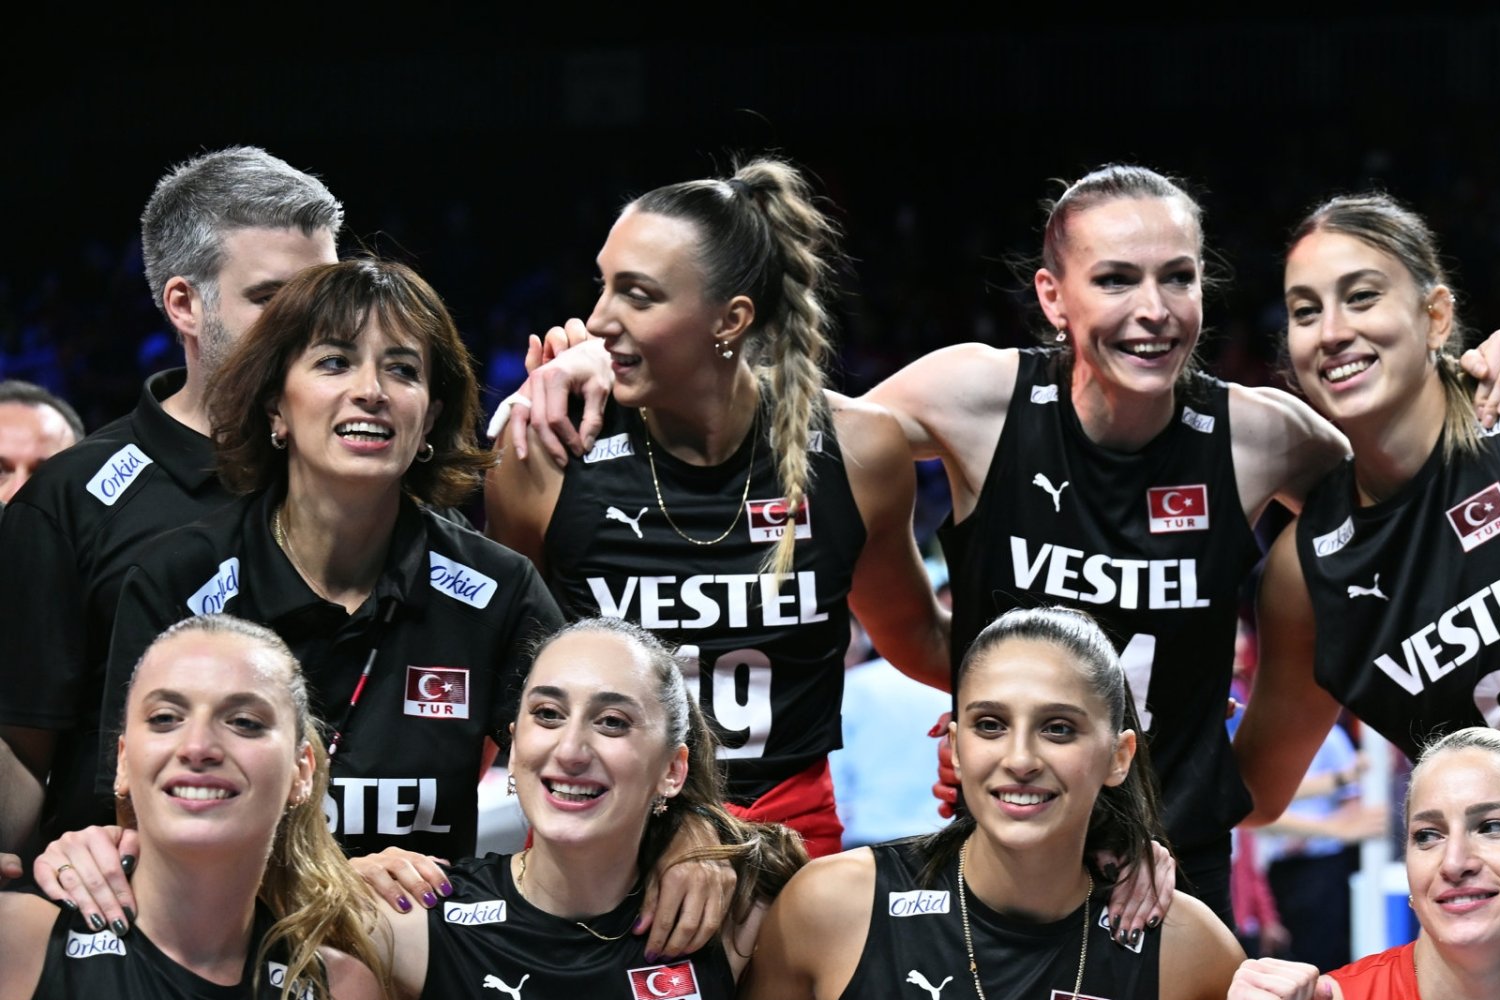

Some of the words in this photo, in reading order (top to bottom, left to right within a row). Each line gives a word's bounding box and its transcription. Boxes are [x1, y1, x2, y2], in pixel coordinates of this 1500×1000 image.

[99, 453, 144, 498] Orkid
[1164, 518, 1196, 529] TUR
[430, 566, 482, 601] Orkid
[1009, 536, 1211, 609] VESTEL
[587, 571, 829, 629] VESTEL
[418, 703, 453, 715] TUR
[446, 902, 503, 923] Orkid
[890, 892, 946, 915] Orkid
[68, 935, 121, 957] Orkid
